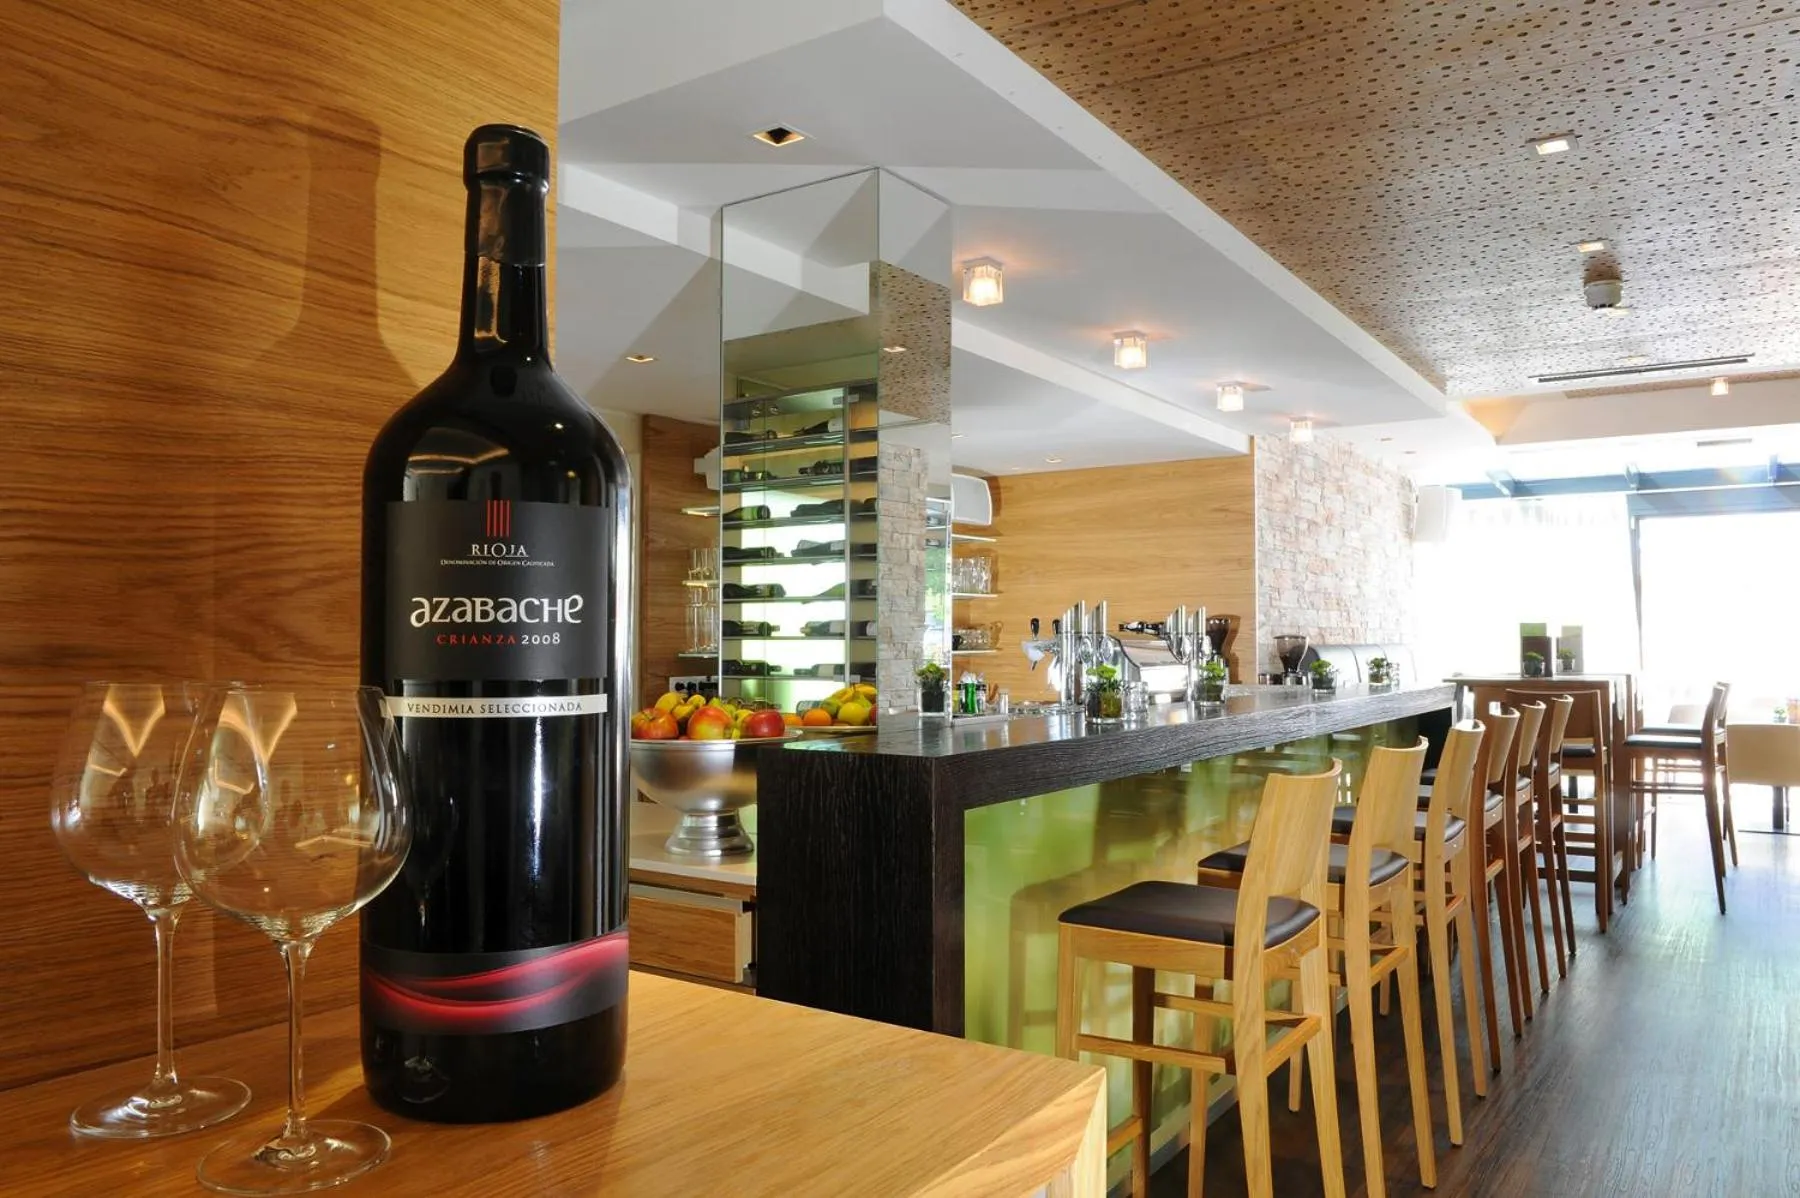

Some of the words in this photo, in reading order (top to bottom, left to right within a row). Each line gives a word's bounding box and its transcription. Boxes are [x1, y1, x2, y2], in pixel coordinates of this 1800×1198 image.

[471, 542, 528, 558] RIOJA
[436, 633, 517, 646] CRIANZA
[521, 632, 561, 645] 2008
[407, 703, 474, 714] VENDIMIA
[480, 702, 582, 714] SELECCIONADA
